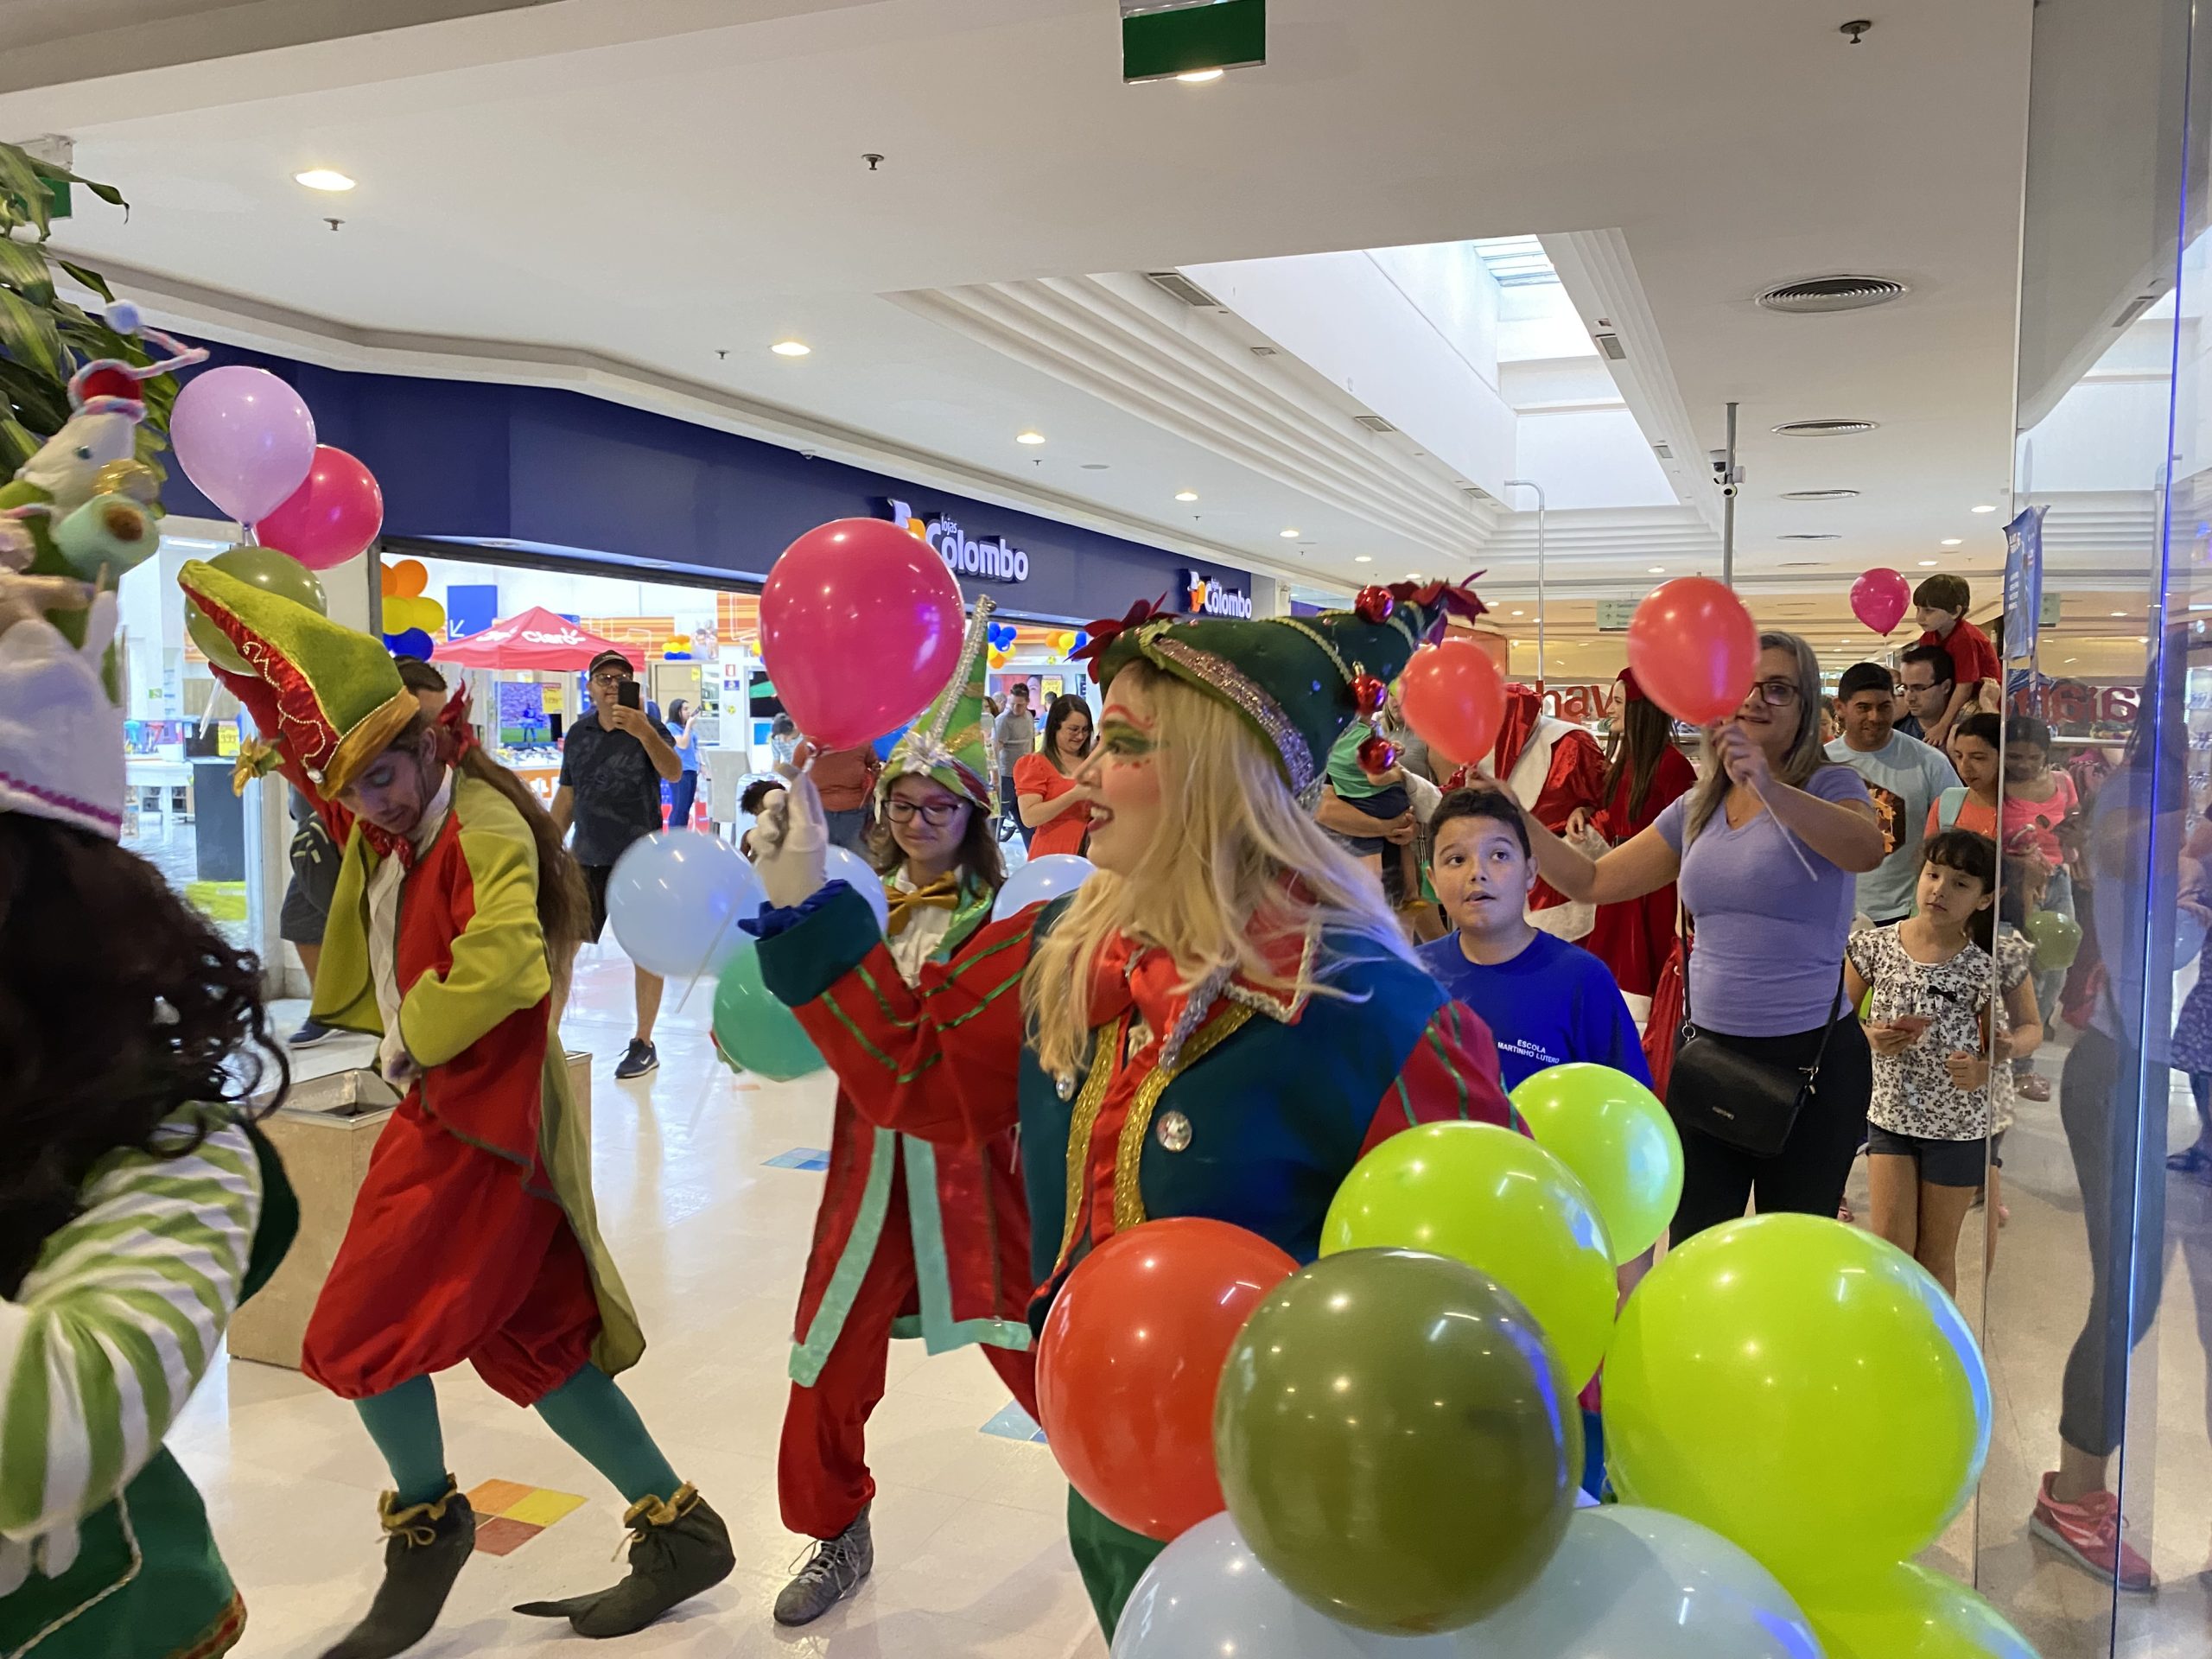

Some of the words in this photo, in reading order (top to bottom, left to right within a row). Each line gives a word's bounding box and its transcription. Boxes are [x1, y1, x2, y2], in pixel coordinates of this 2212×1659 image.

[940, 516, 957, 535] lojas
[925, 522, 1028, 581] Colombo
[1205, 582, 1252, 619] Colombo
[521, 627, 586, 645] Claro
[1497, 1041, 1534, 1058] MARTINHO
[1535, 1053, 1560, 1064] LUTERO
[1516, 1039, 1546, 1054] ESCOLA
